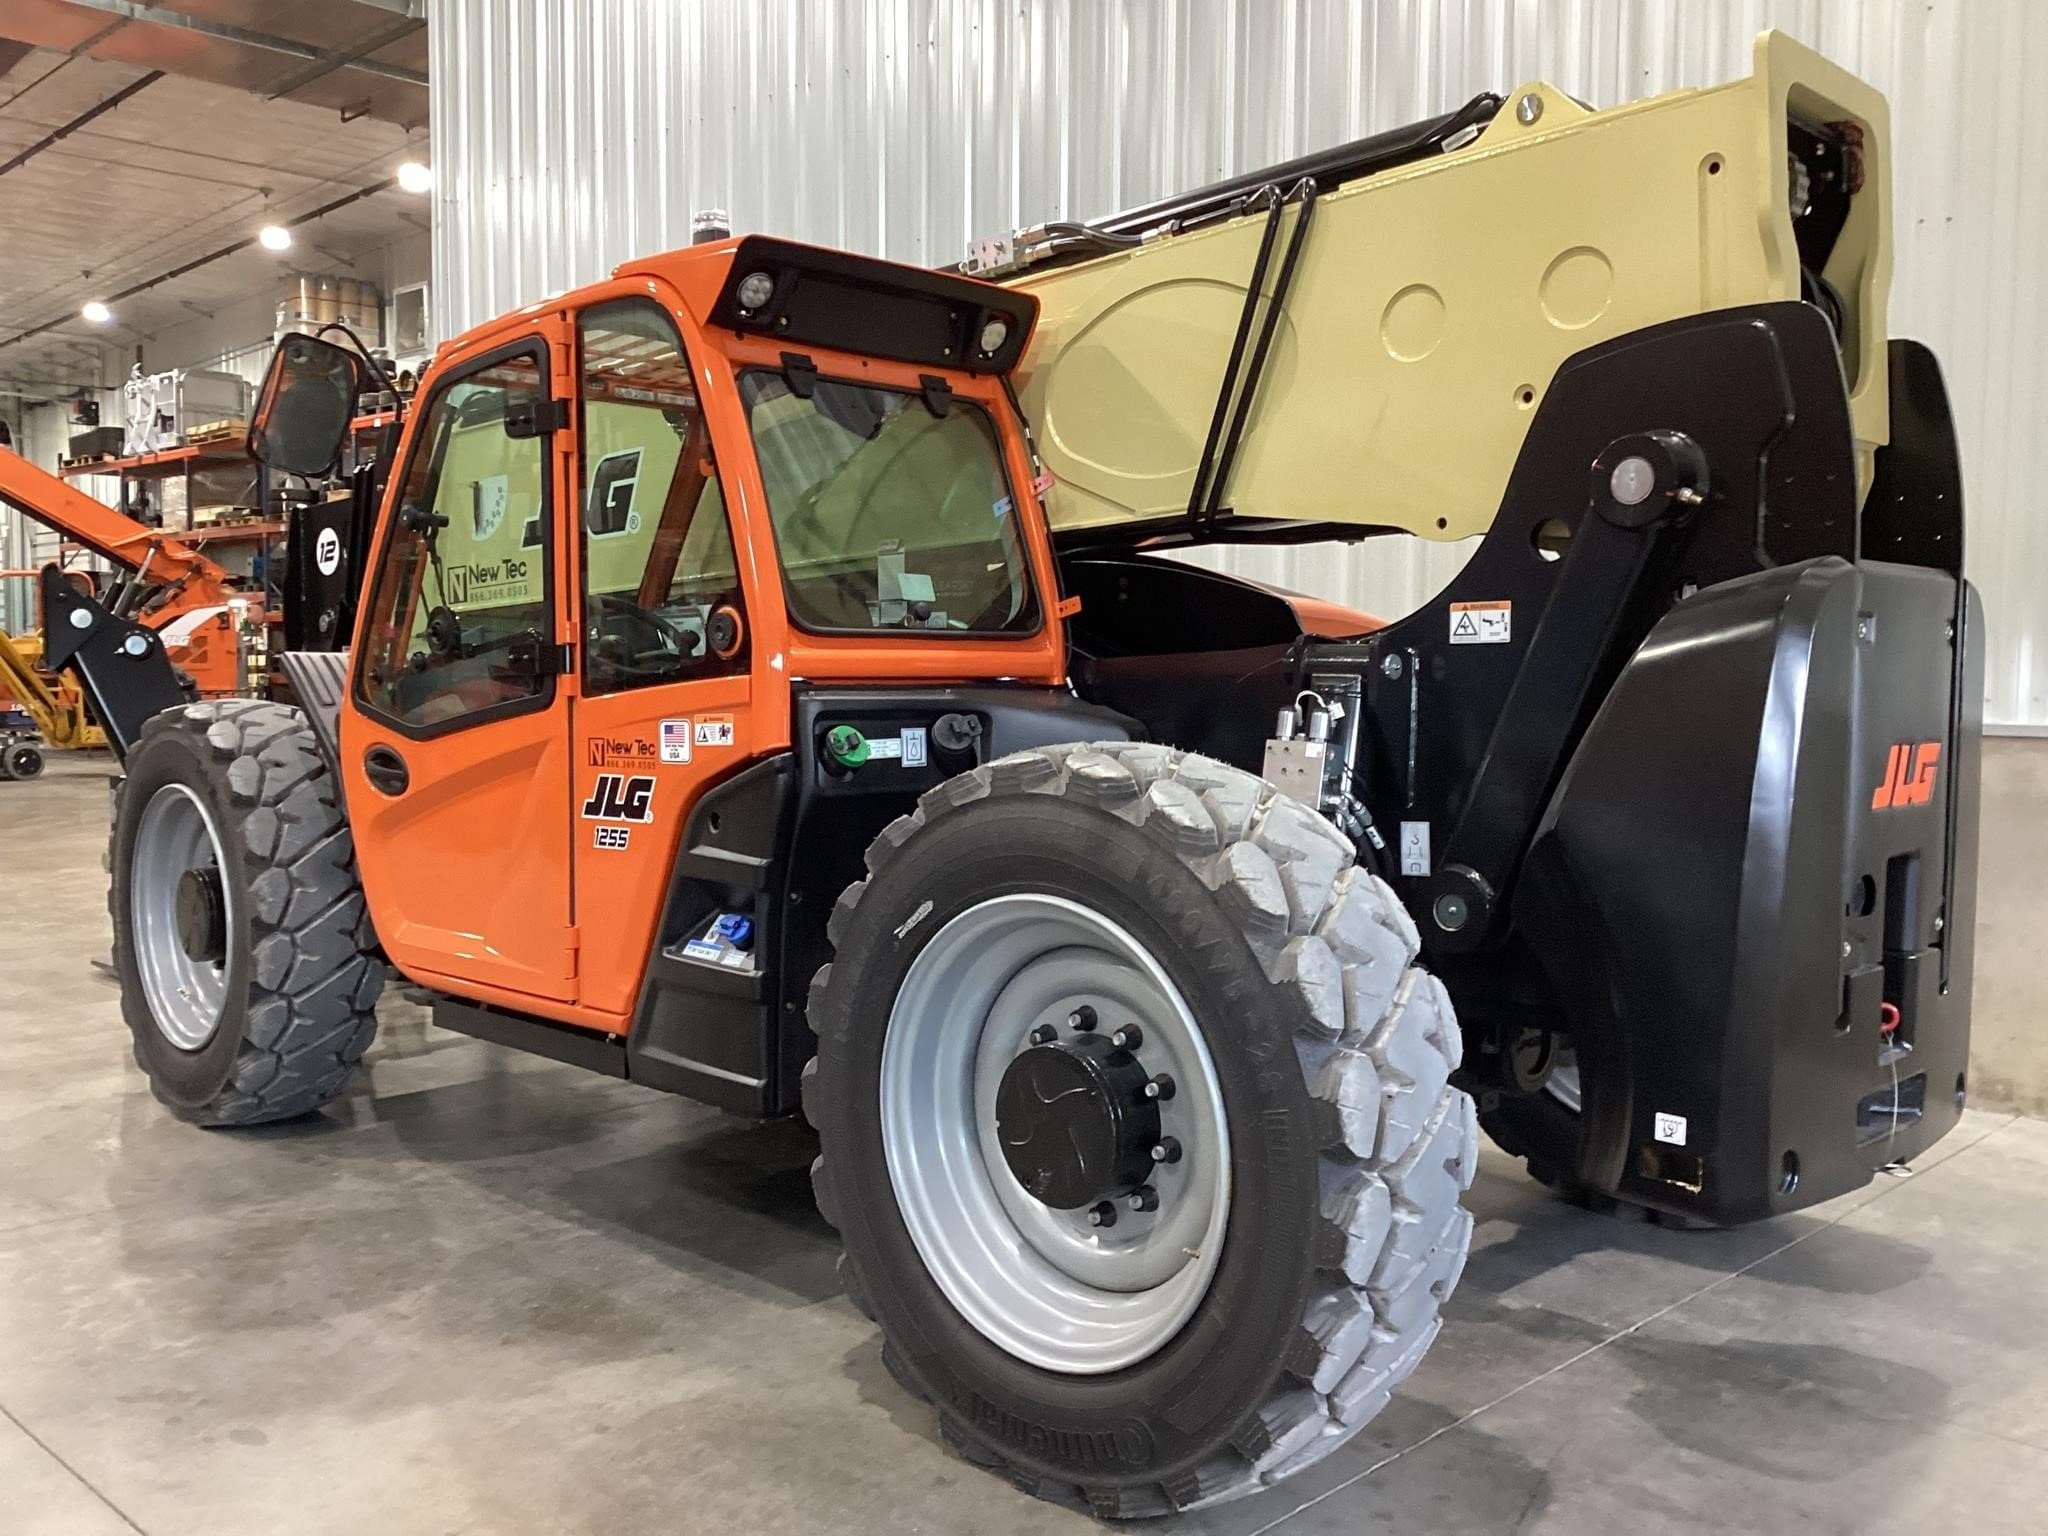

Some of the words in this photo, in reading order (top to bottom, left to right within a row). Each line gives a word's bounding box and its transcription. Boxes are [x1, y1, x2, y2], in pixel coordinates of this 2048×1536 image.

[320, 540, 336, 563] 12
[469, 564, 500, 585] New
[502, 558, 527, 579] Tec
[606, 738, 633, 754] New
[634, 739, 656, 755] Tec
[1872, 743, 1942, 810] JLG
[583, 775, 655, 821] JLG
[595, 827, 629, 848] 1255
